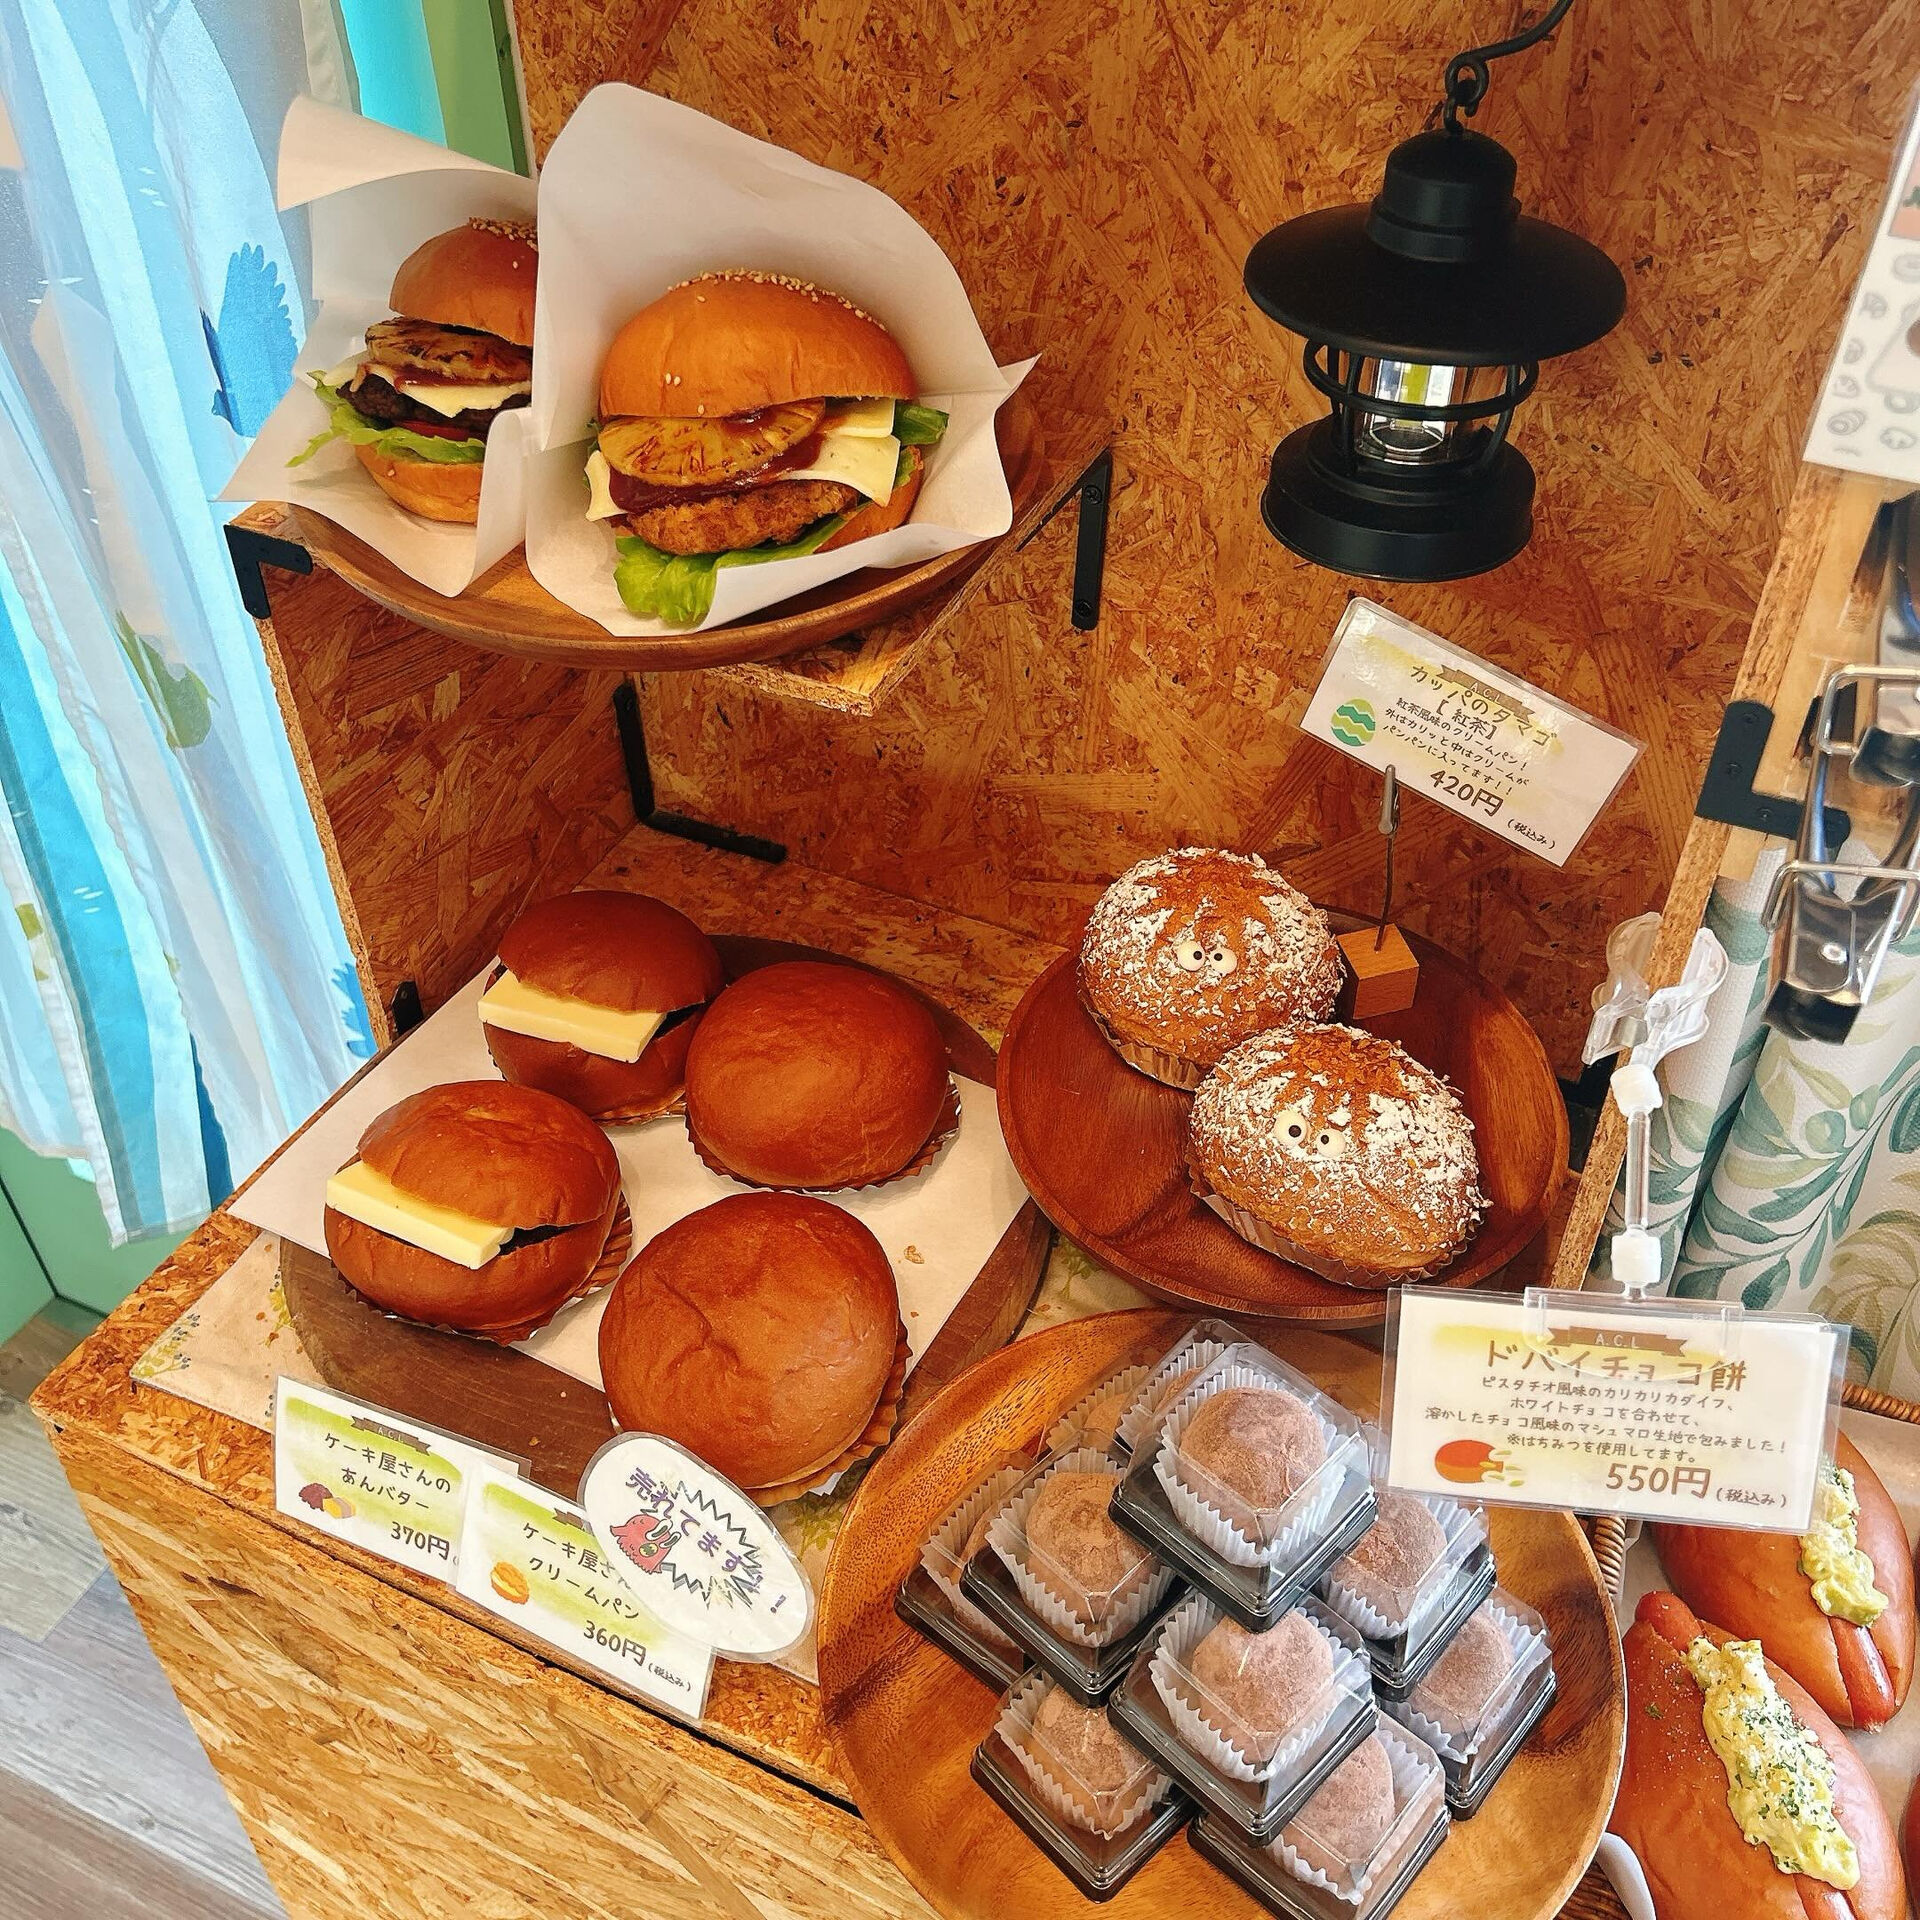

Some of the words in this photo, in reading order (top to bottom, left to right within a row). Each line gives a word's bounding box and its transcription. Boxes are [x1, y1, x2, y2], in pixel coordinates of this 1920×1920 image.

[1410, 665, 1557, 746] カッパのタマゴ
[1385, 708, 1530, 786] 外はカリッと中はクリームが
[1430, 770, 1504, 817] 420円
[1595, 1333, 1640, 1349] A.C.L
[1488, 1340, 1747, 1392] ドバイチョコ餅
[1482, 1375, 1734, 1411] ピスタチオ風味のカリカリカダイフ、
[1510, 1397, 1700, 1427] ホワイトチョコを合わせて、
[324, 1432, 451, 1494] ケーキ屋さんの
[1605, 1462, 1711, 1499] 550円
[341, 1467, 430, 1509] あんバター
[390, 1521, 450, 1561] 370円
[529, 1557, 639, 1619] クリームパン
[583, 1620, 647, 1666] 360円
